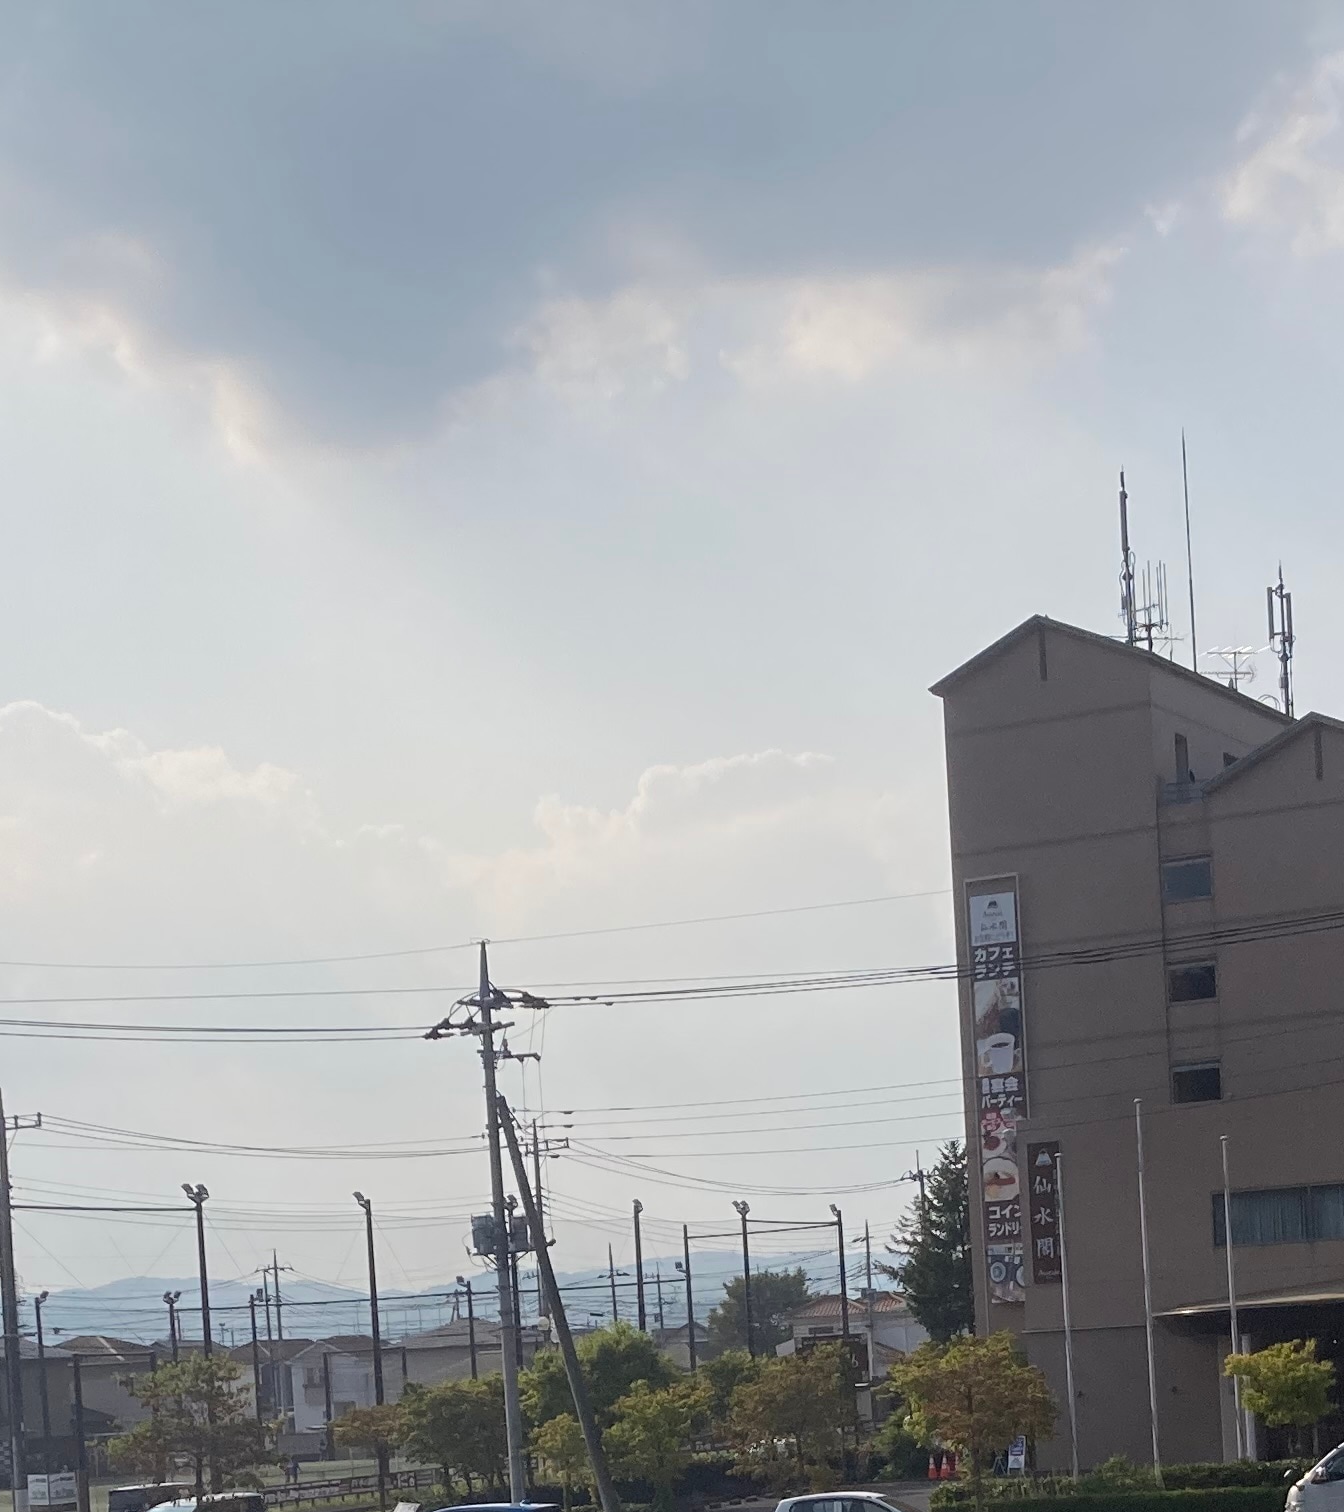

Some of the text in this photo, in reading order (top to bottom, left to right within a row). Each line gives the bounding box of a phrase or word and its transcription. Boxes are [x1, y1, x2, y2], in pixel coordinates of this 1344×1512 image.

[975, 946, 1014, 963] カフェ
[982, 1093, 1023, 1109] パーティー
[988, 1204, 1022, 1219] コイン
[988, 1221, 1023, 1237] ランドリ
